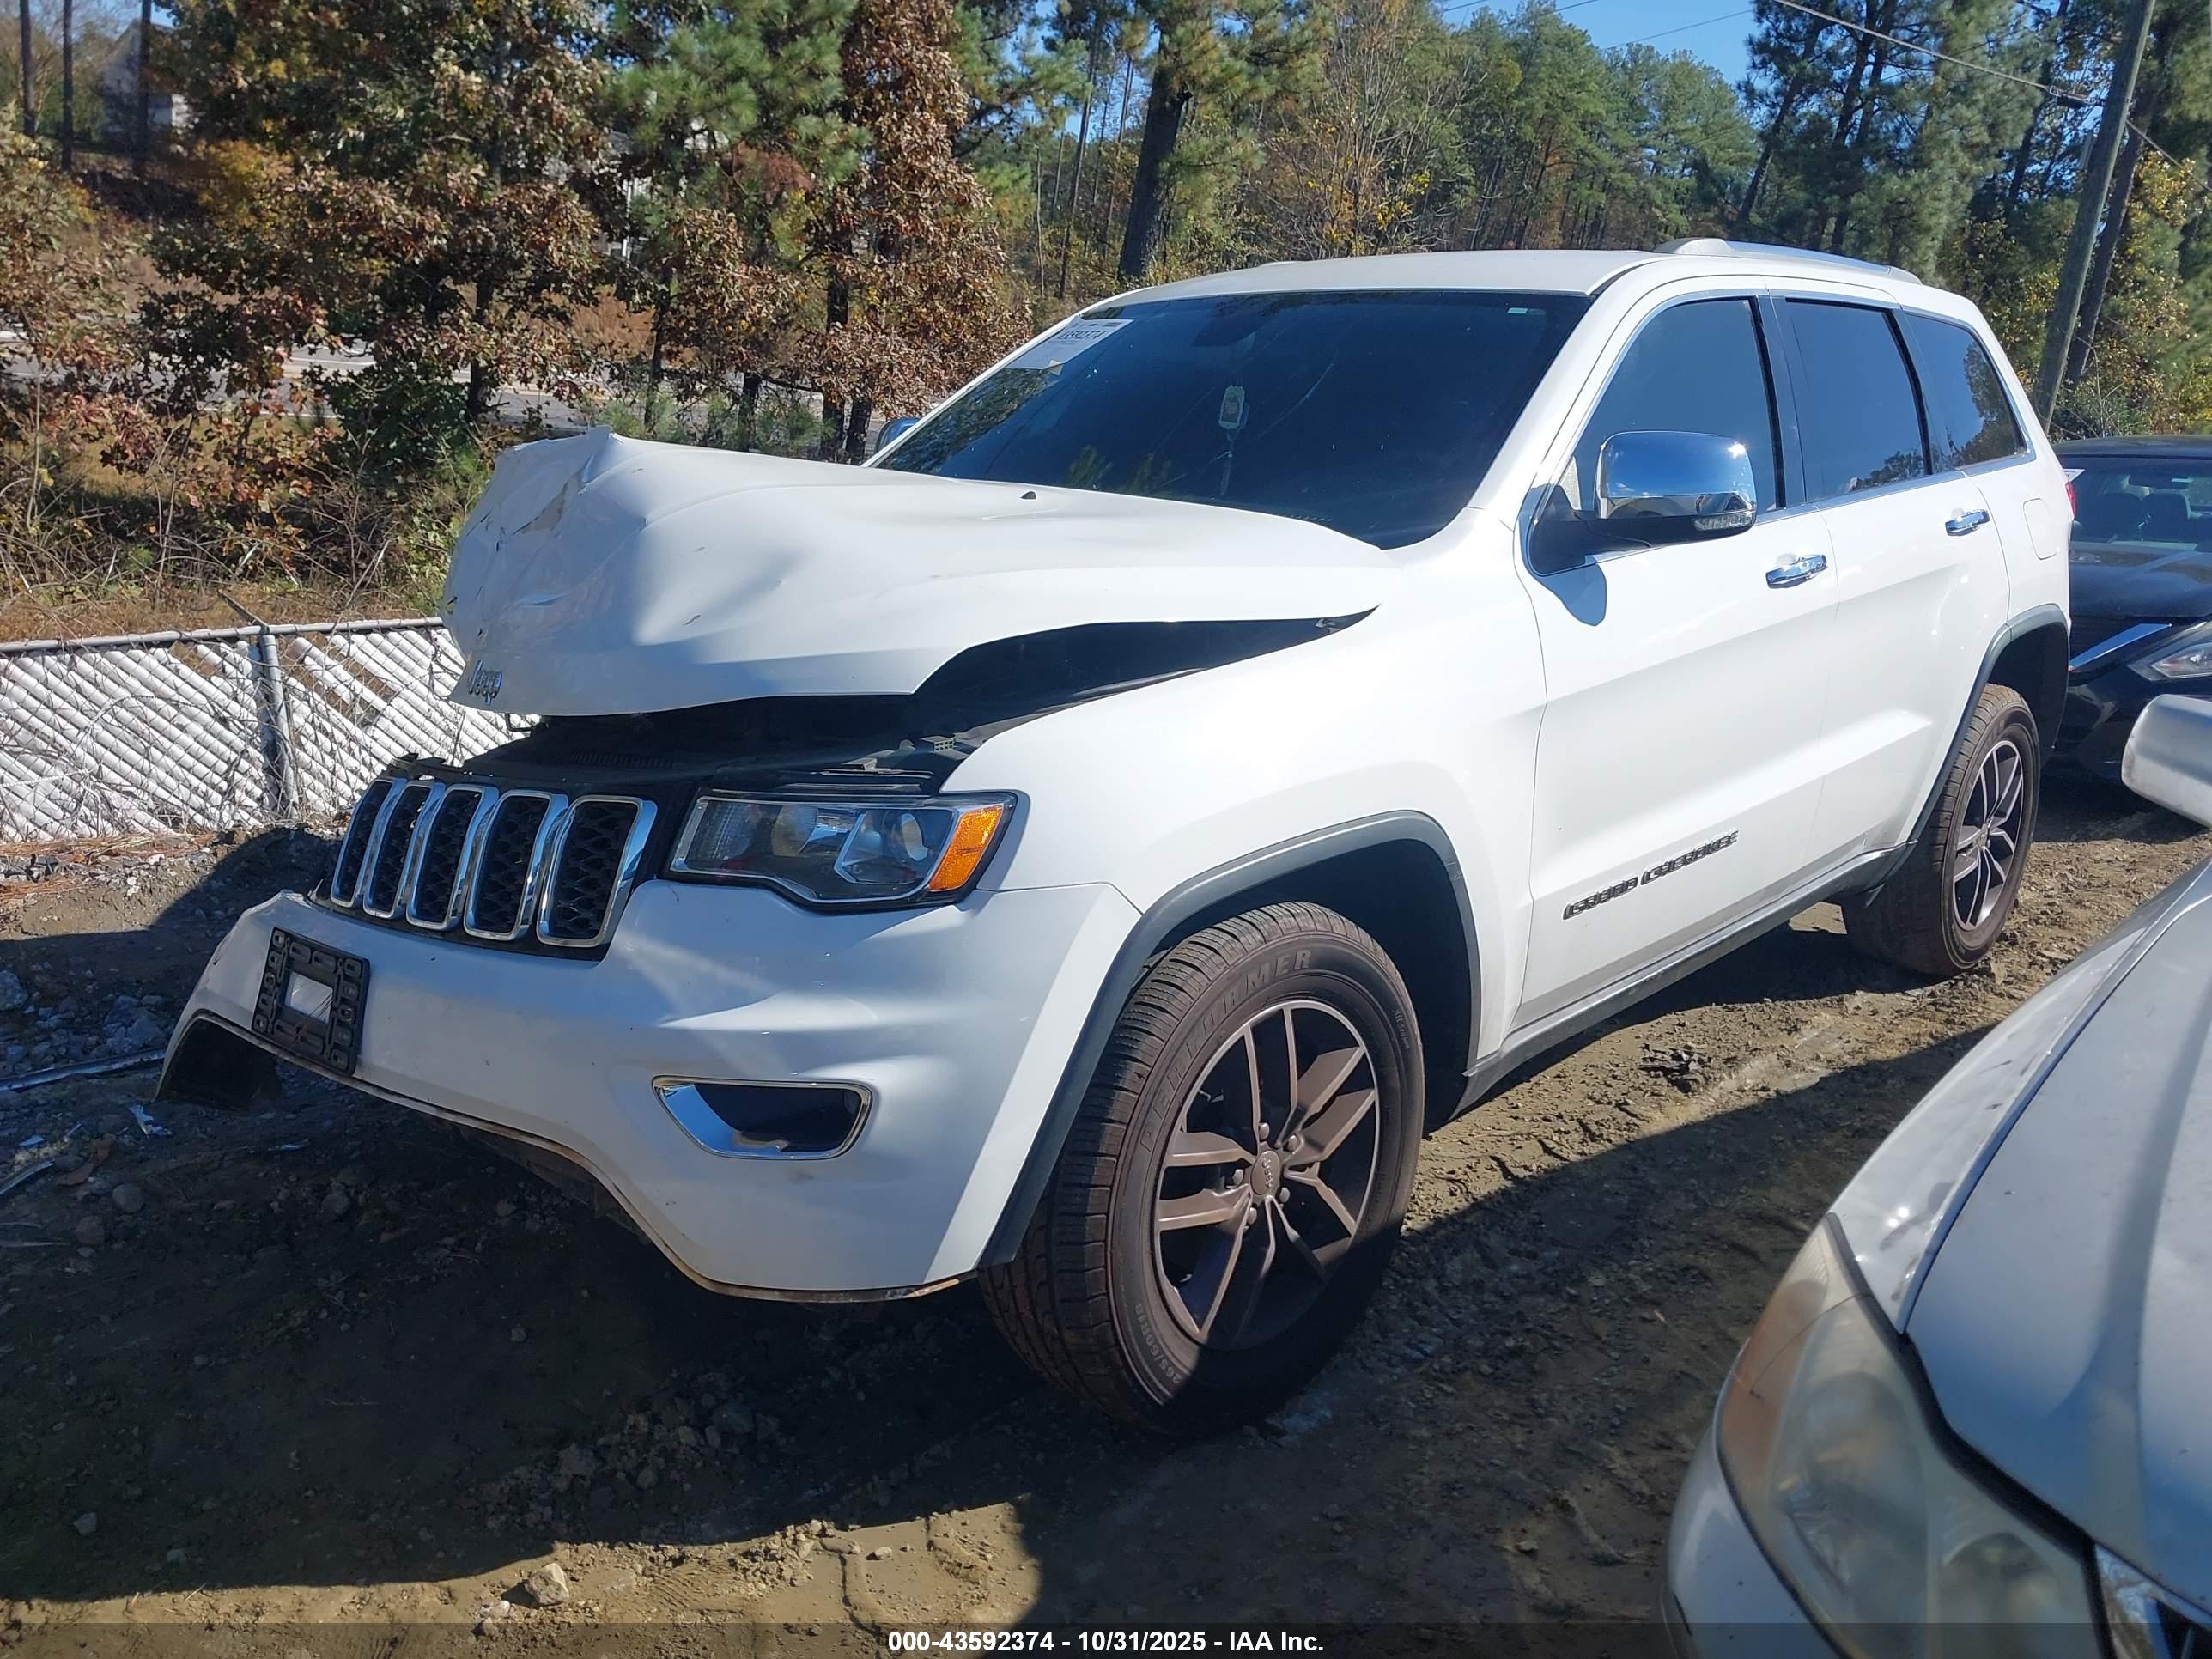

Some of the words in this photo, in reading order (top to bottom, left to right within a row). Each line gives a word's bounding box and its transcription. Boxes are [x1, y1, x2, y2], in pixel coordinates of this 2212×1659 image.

[468, 659, 502, 705] Jeep
[1563, 876, 1638, 920] GRAND
[1641, 830, 1738, 885] CHEROKEE
